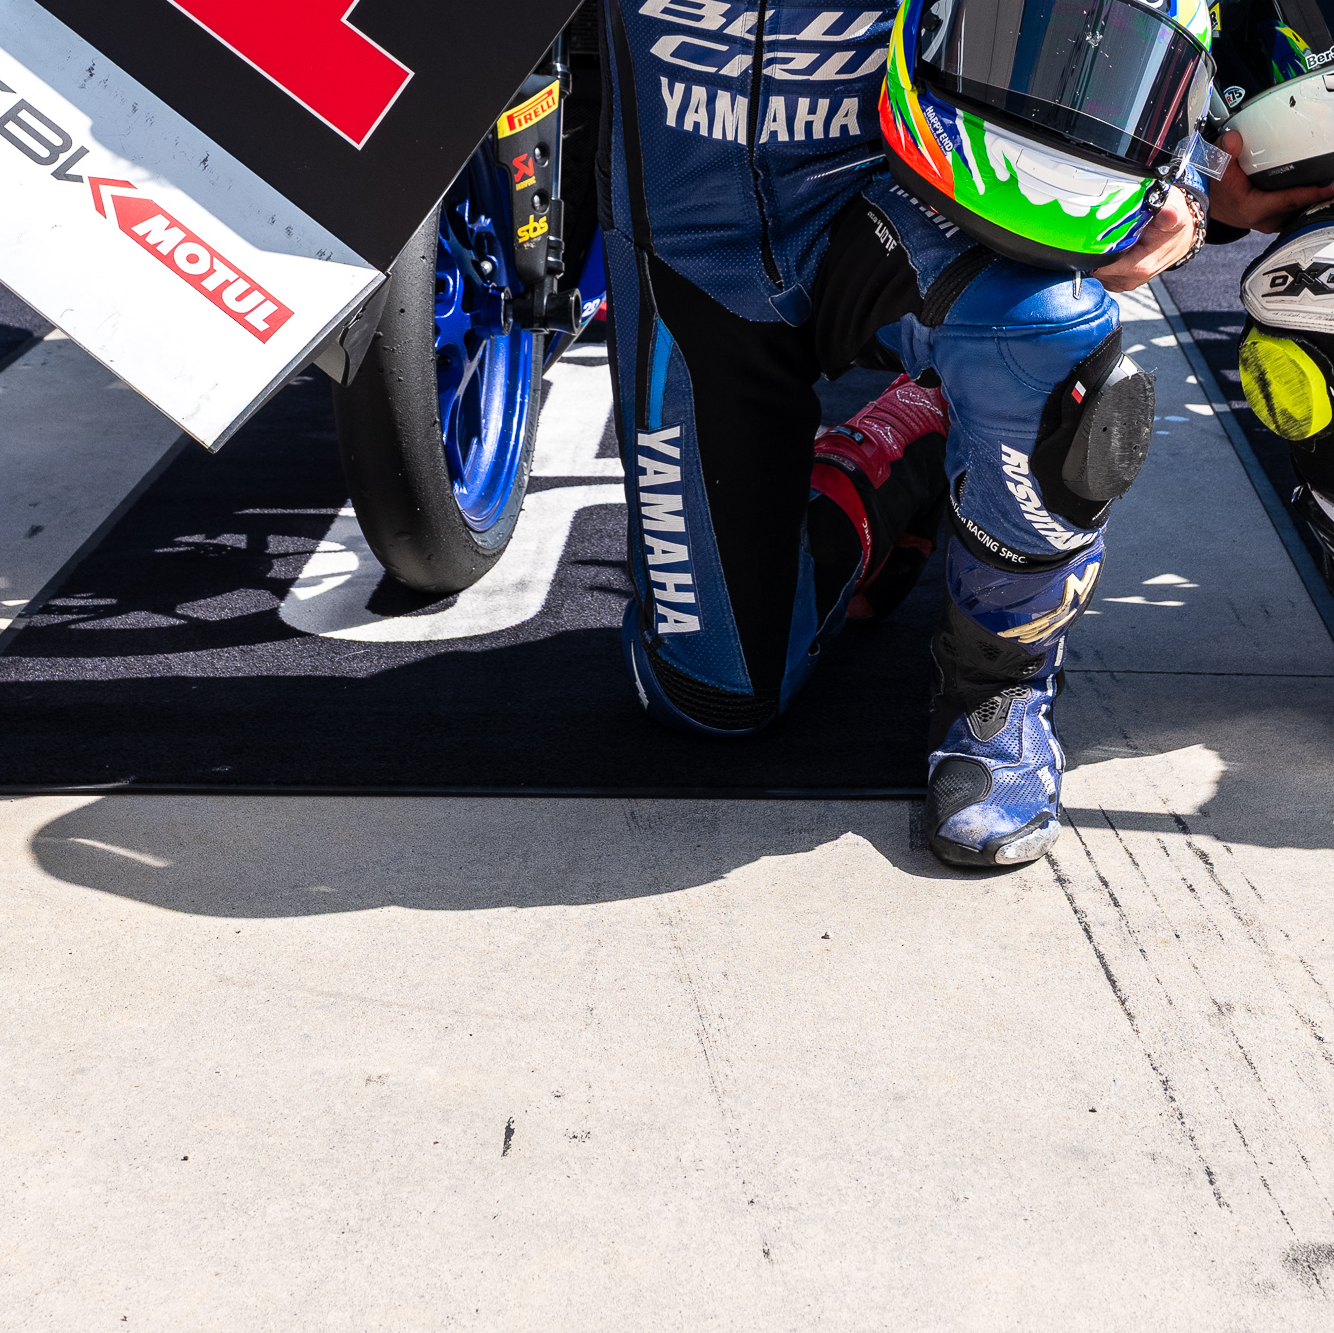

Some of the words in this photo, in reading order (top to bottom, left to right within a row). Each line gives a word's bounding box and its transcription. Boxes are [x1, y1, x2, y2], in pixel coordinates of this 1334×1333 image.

[650, 35, 890, 81] CRU
[506, 88, 555, 132] PIRELLI
[660, 76, 865, 146] YAMAHA
[1226, 88, 1244, 104] R75
[925, 105, 944, 134] HAPPY
[939, 128, 954, 152] END
[517, 214, 549, 244] sbs
[132, 201, 285, 335] MOTUL
[636, 429, 703, 636] YAMAHA
[966, 520, 998, 553] RACING
[999, 547, 1028, 565] SPEC.
